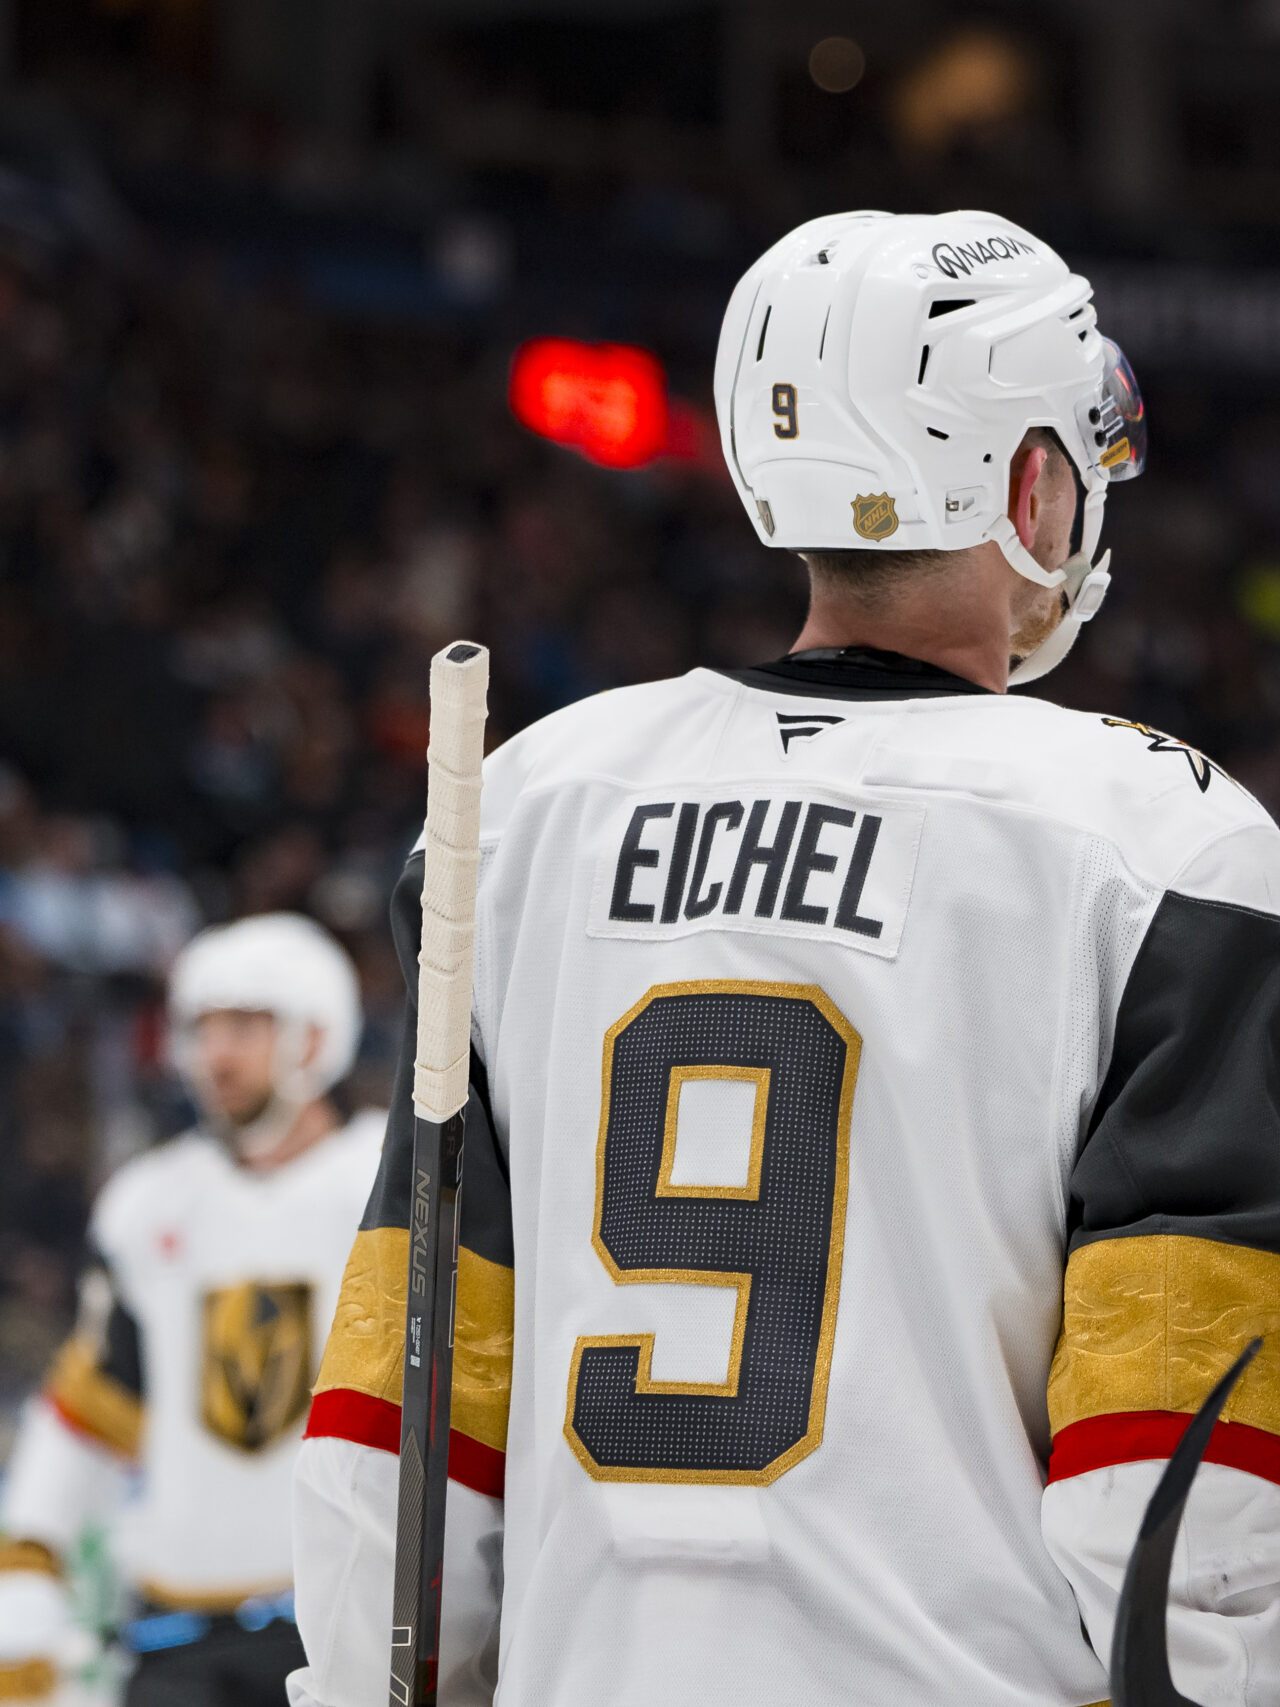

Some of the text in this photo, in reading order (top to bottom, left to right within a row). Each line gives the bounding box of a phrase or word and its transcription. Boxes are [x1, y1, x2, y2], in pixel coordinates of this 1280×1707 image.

[772, 383, 799, 440] 9
[863, 506, 887, 530] NHL
[608, 799, 883, 939] EICHEL
[412, 1168, 431, 1297] NEXUS
[563, 978, 863, 1488] 9
